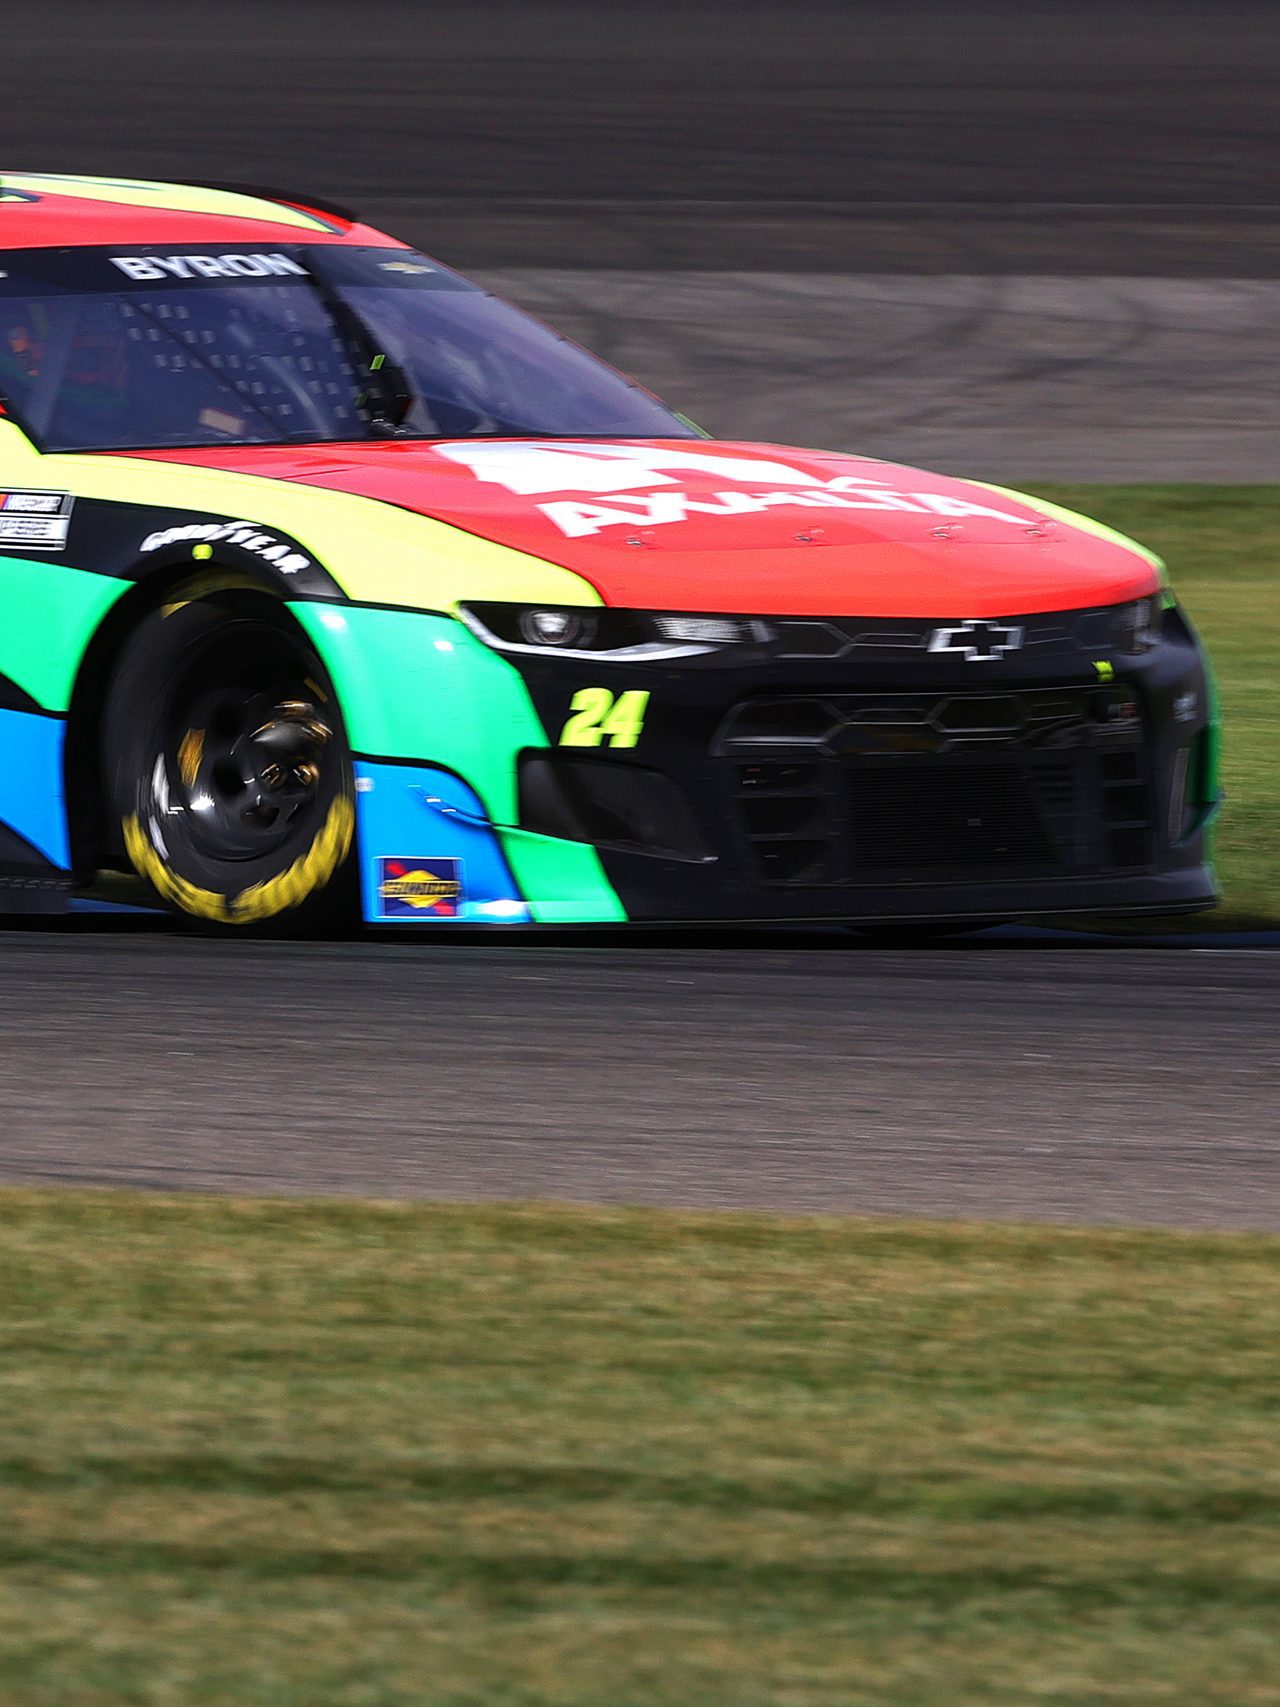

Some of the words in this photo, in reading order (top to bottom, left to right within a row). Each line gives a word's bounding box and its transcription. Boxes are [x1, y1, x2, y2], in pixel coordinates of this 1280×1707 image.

[108, 253, 312, 280] BYRON
[536, 475, 1040, 538] AXALTA
[139, 520, 312, 575] GOODYEAR
[558, 687, 651, 749] 24
